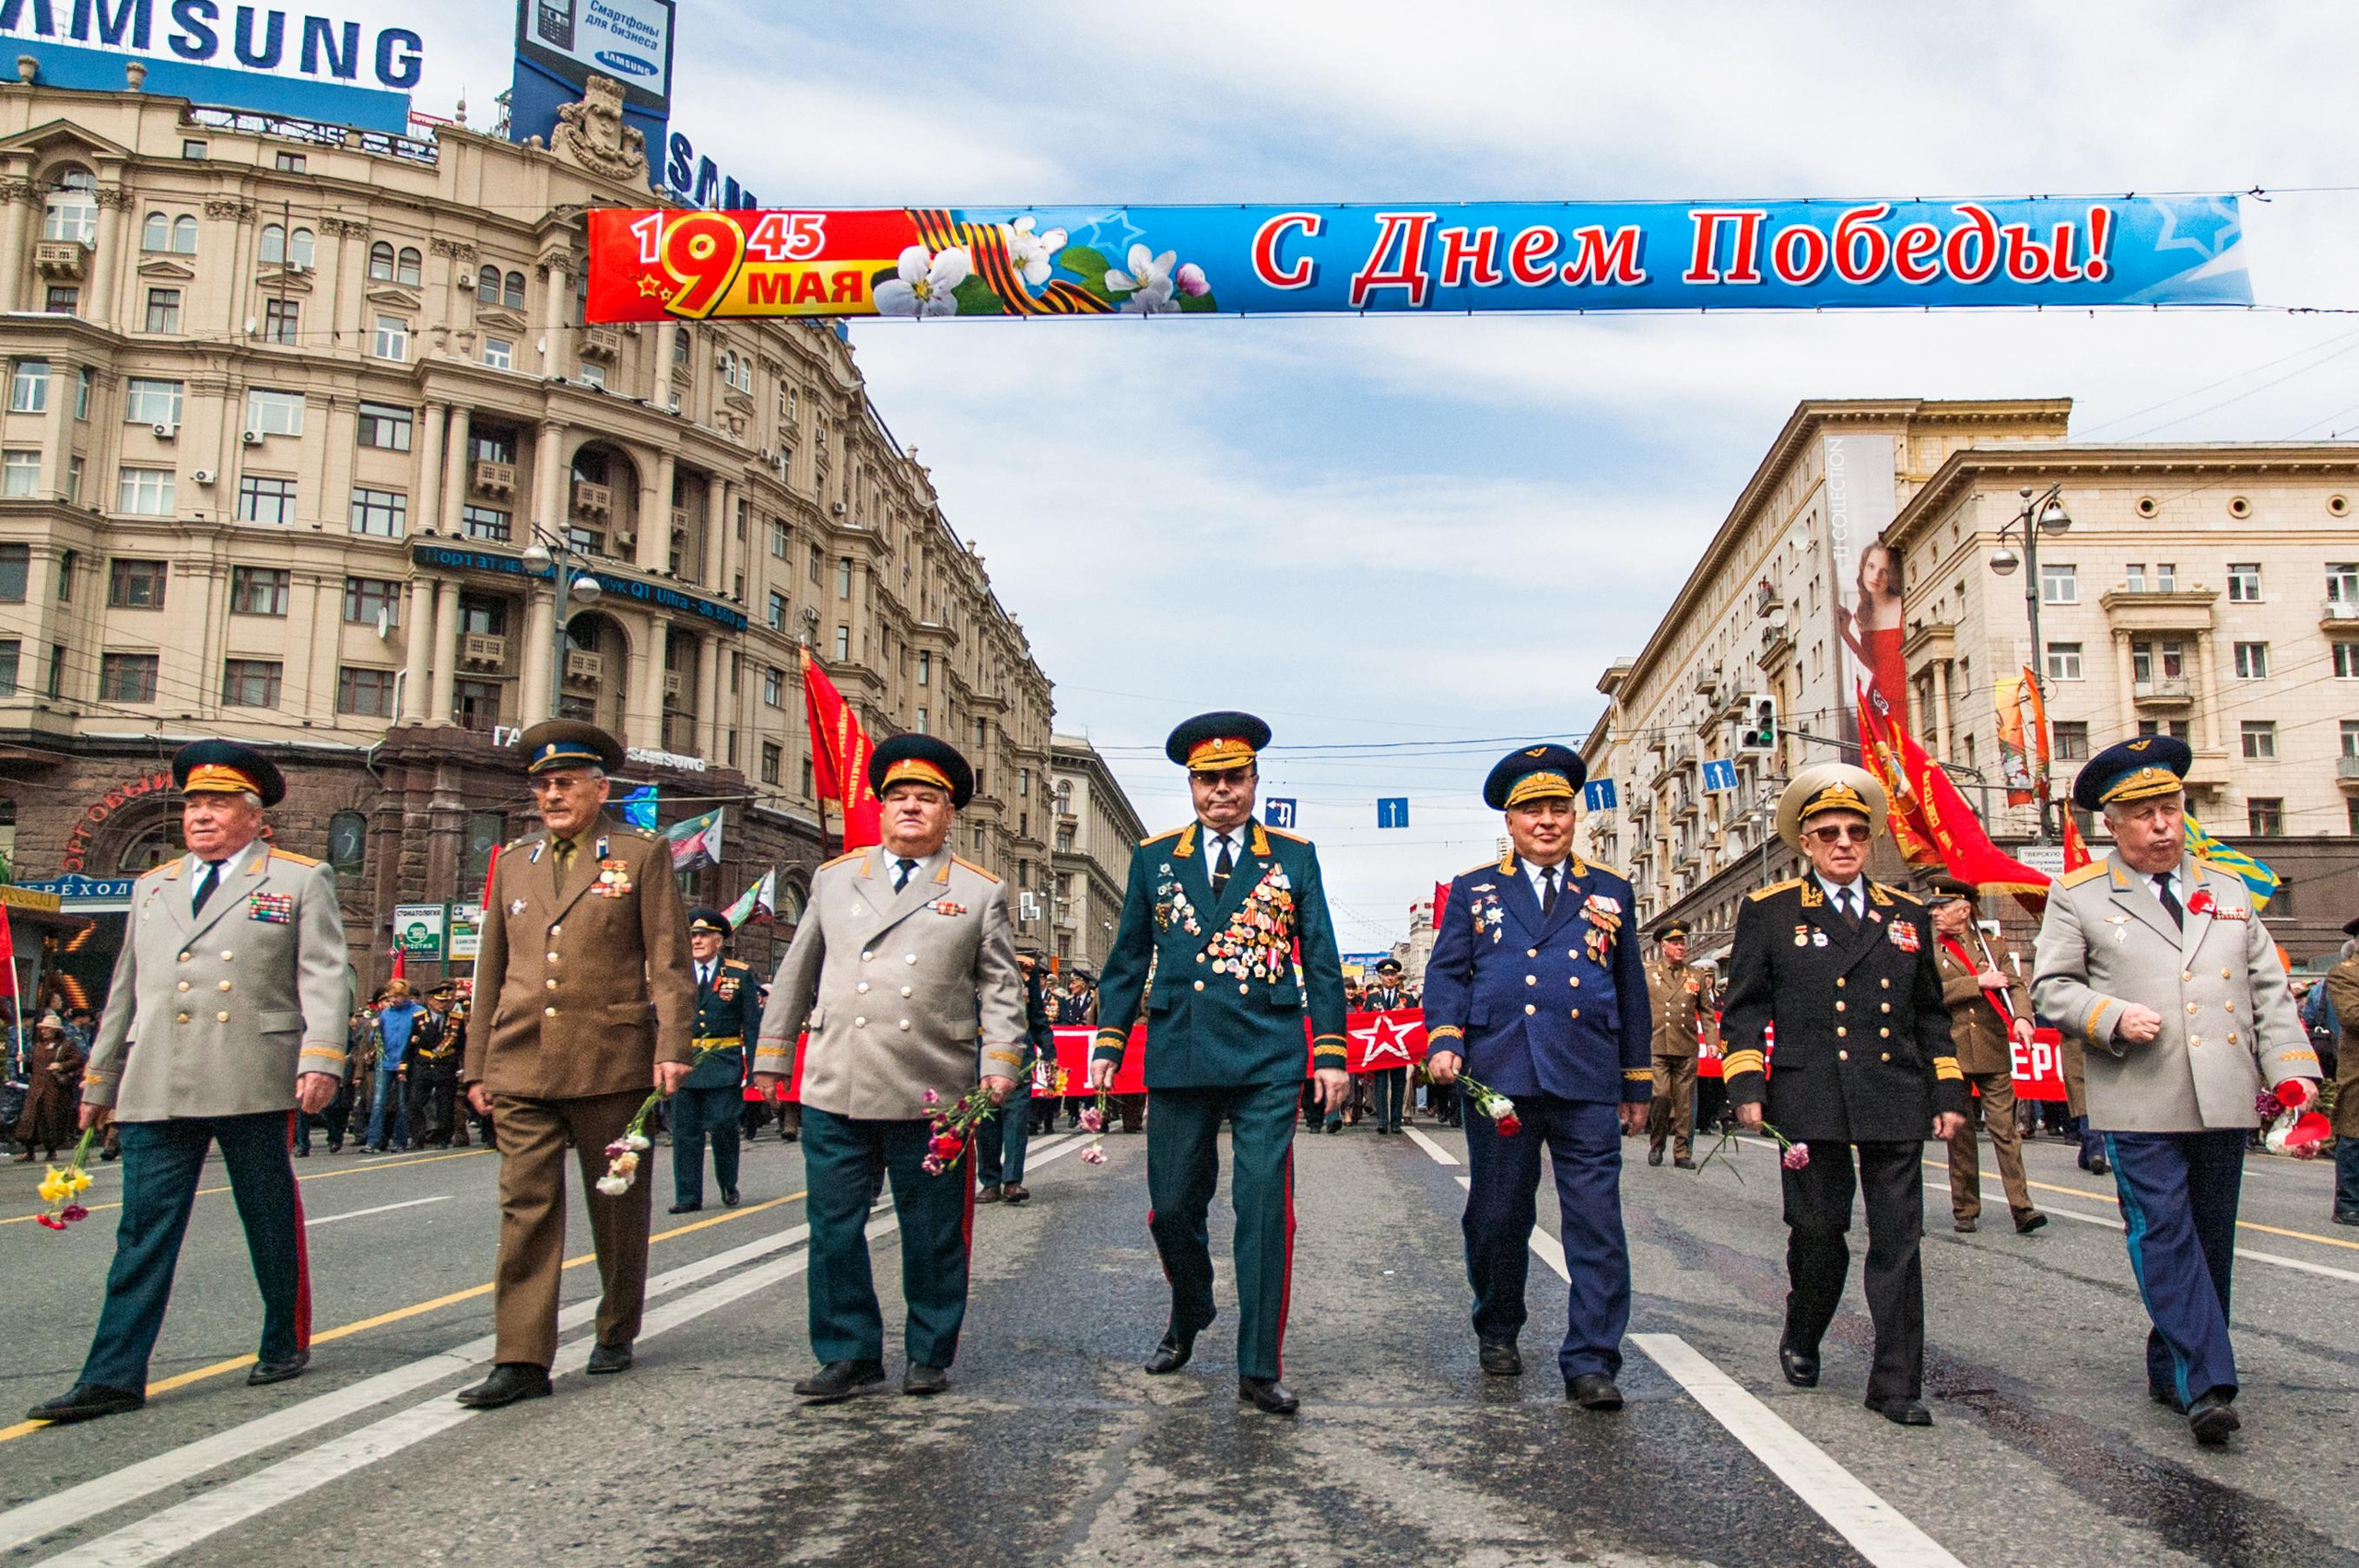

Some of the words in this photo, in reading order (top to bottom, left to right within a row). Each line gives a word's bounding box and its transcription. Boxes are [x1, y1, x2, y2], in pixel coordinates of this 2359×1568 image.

[585, 14, 607, 29] для
[610, 23, 659, 51] бизнеса
[590, 0, 660, 38] Смартфоны
[0, 0, 424, 89] AMSUNG
[603, 51, 651, 76] SAMSUNG
[1250, 212, 1321, 289] С
[1349, 211, 1647, 308] Днем
[1683, 201, 2111, 286] Победы!
[747, 270, 863, 305] МАЯ
[1829, 438, 1848, 541] COLLECTION
[626, 747, 707, 772] SAMSUNG
